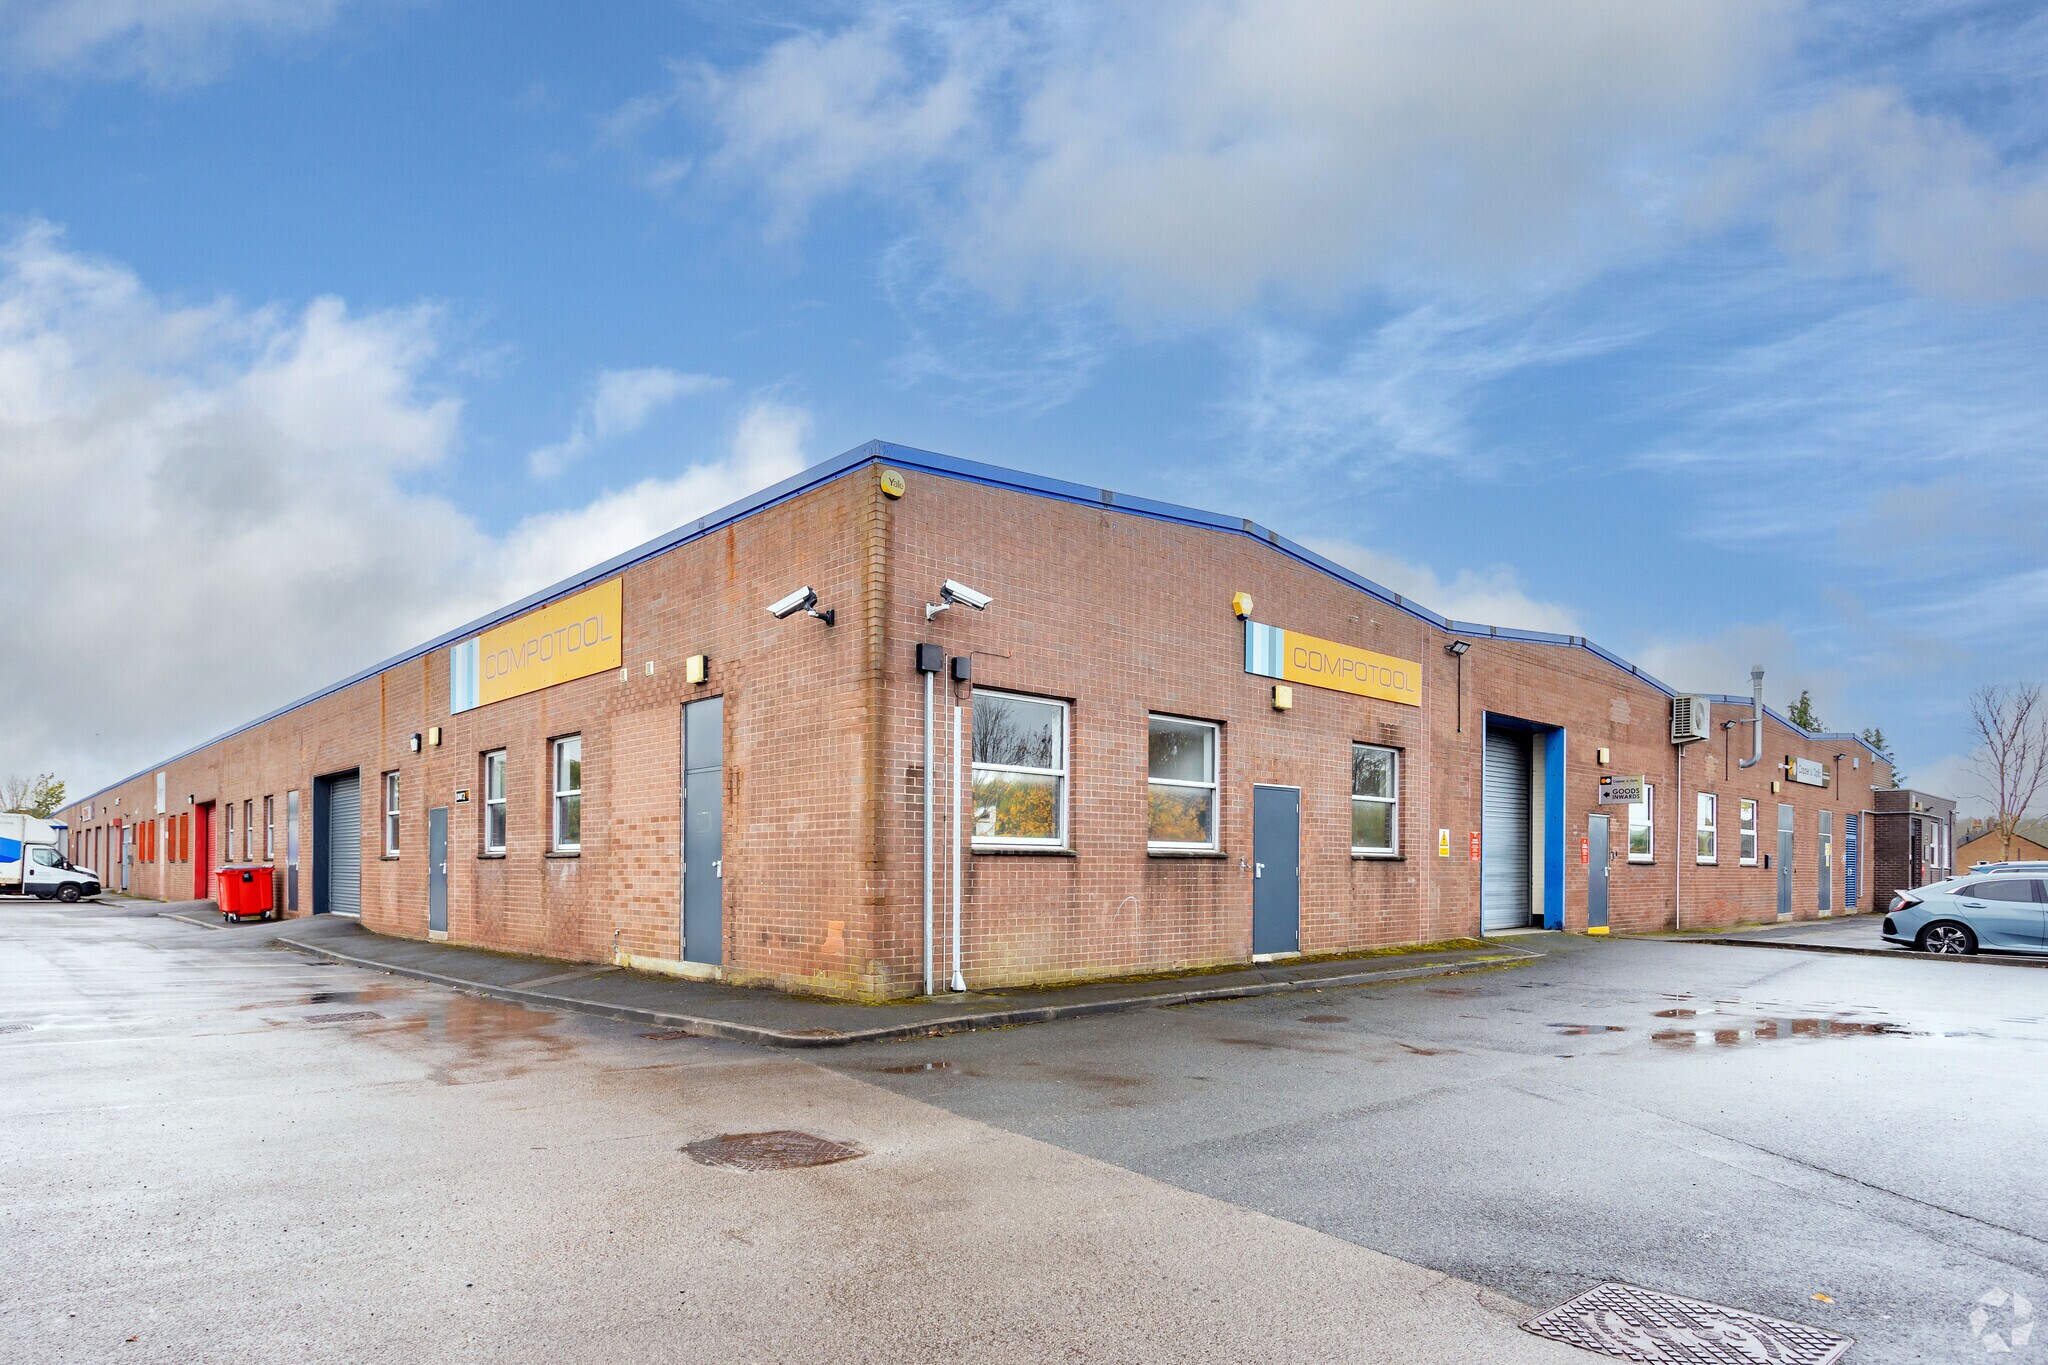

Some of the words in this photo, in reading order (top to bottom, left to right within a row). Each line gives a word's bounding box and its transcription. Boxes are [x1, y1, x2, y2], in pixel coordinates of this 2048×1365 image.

[888, 477, 904, 490] Yale
[485, 613, 613, 680] COMPOTOOL
[1293, 647, 1414, 693] COMPOTOOL
